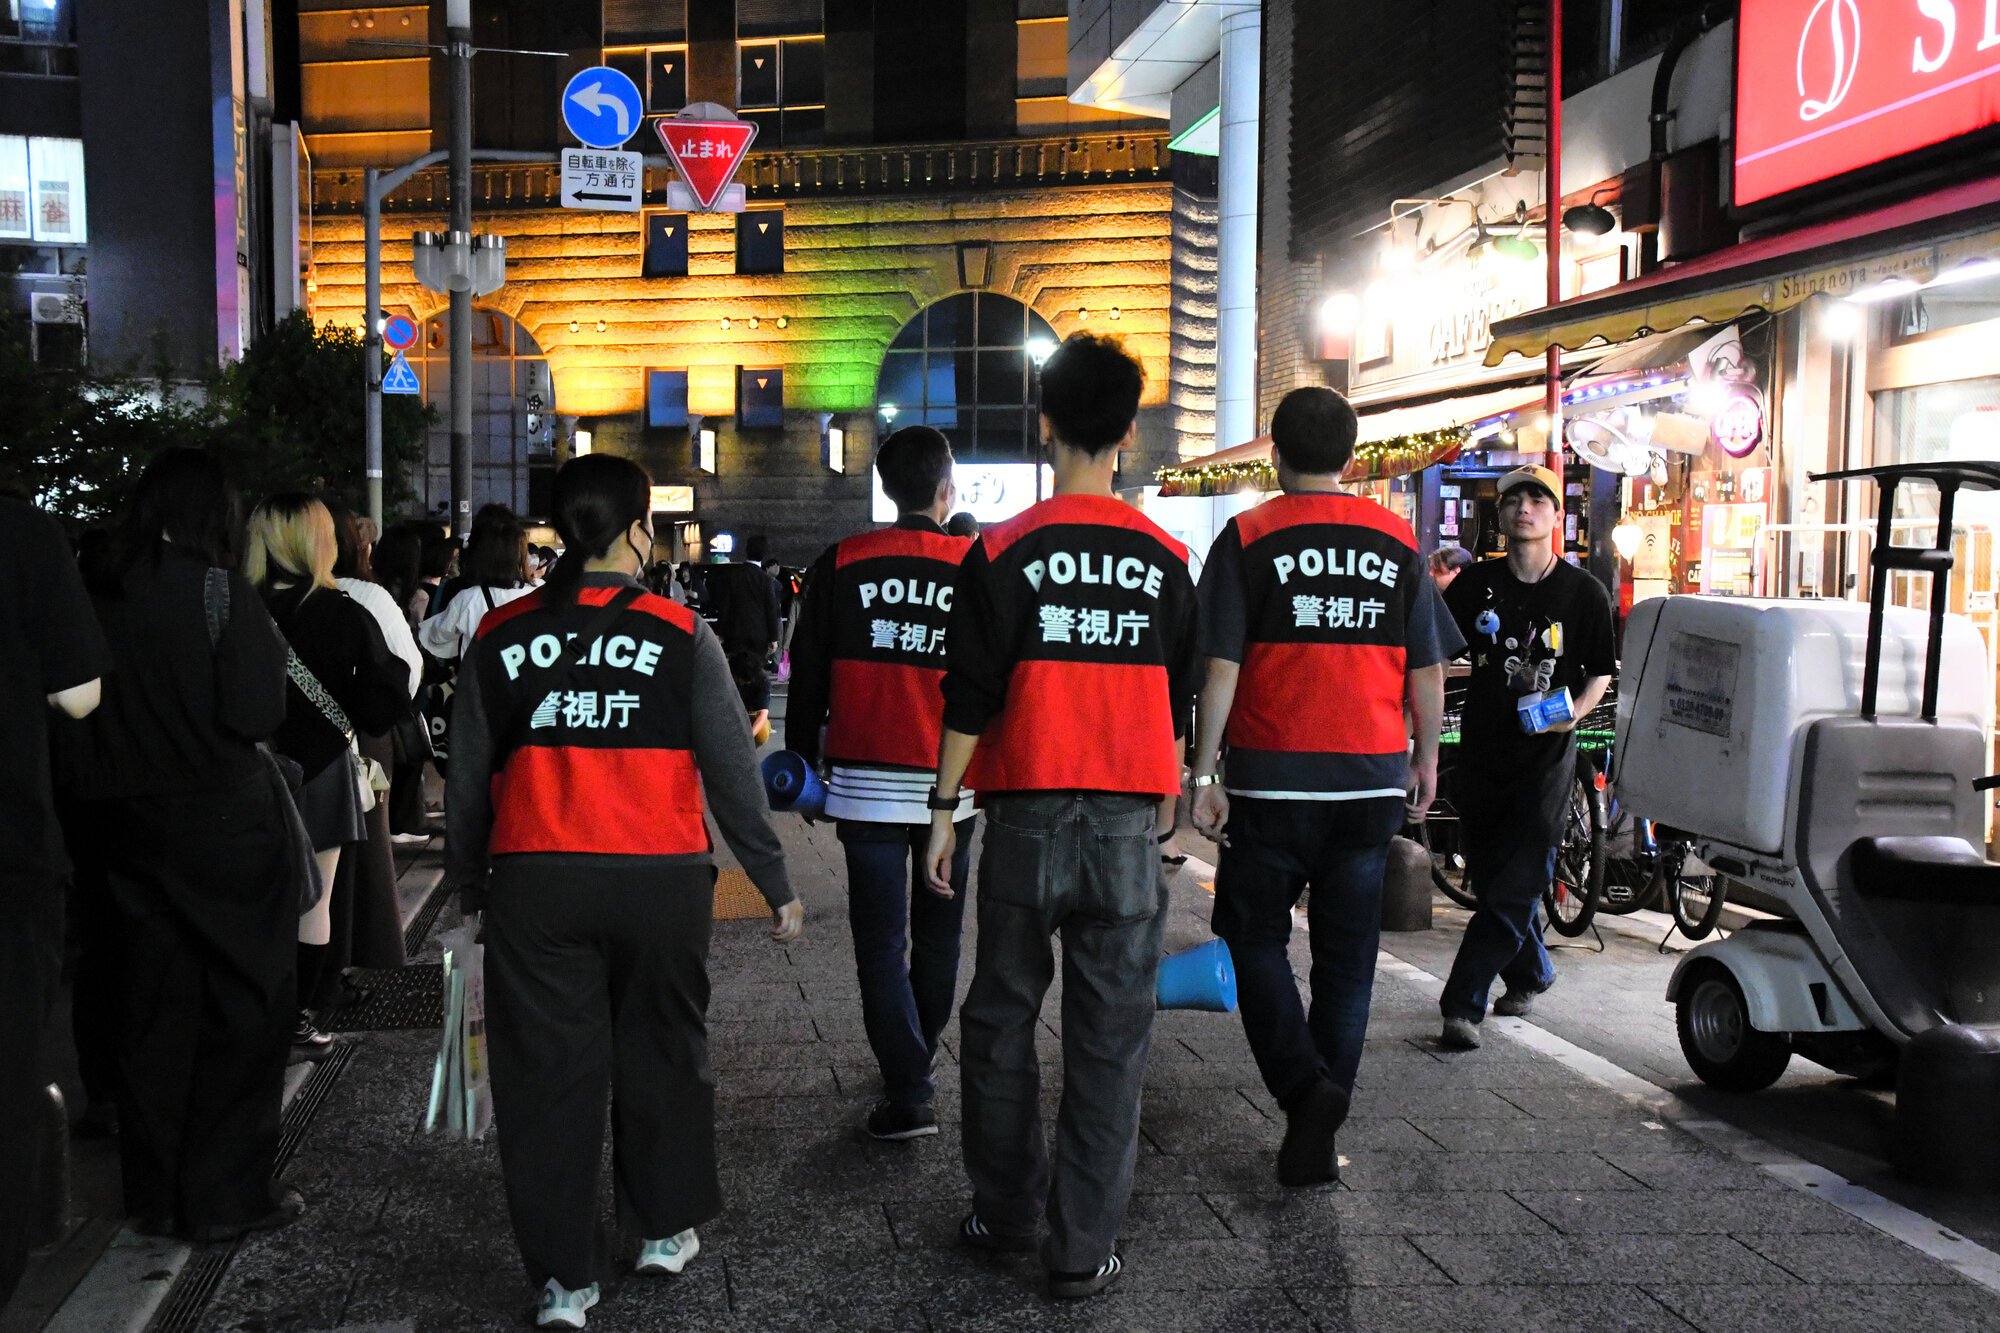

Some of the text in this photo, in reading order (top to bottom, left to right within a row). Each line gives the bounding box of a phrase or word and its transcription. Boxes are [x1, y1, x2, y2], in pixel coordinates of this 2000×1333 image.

[568, 154, 636, 172] 自転車を除く
[679, 139, 734, 159] 止まれ
[568, 173, 636, 189] 一方通行
[1782, 266, 1867, 299] Shinanoya
[1022, 552, 1165, 599] POLICE
[1273, 548, 1399, 589] POLICE
[858, 578, 954, 613] POLIC
[1292, 594, 1386, 629] 警視庁
[1038, 604, 1150, 647] 警視庁
